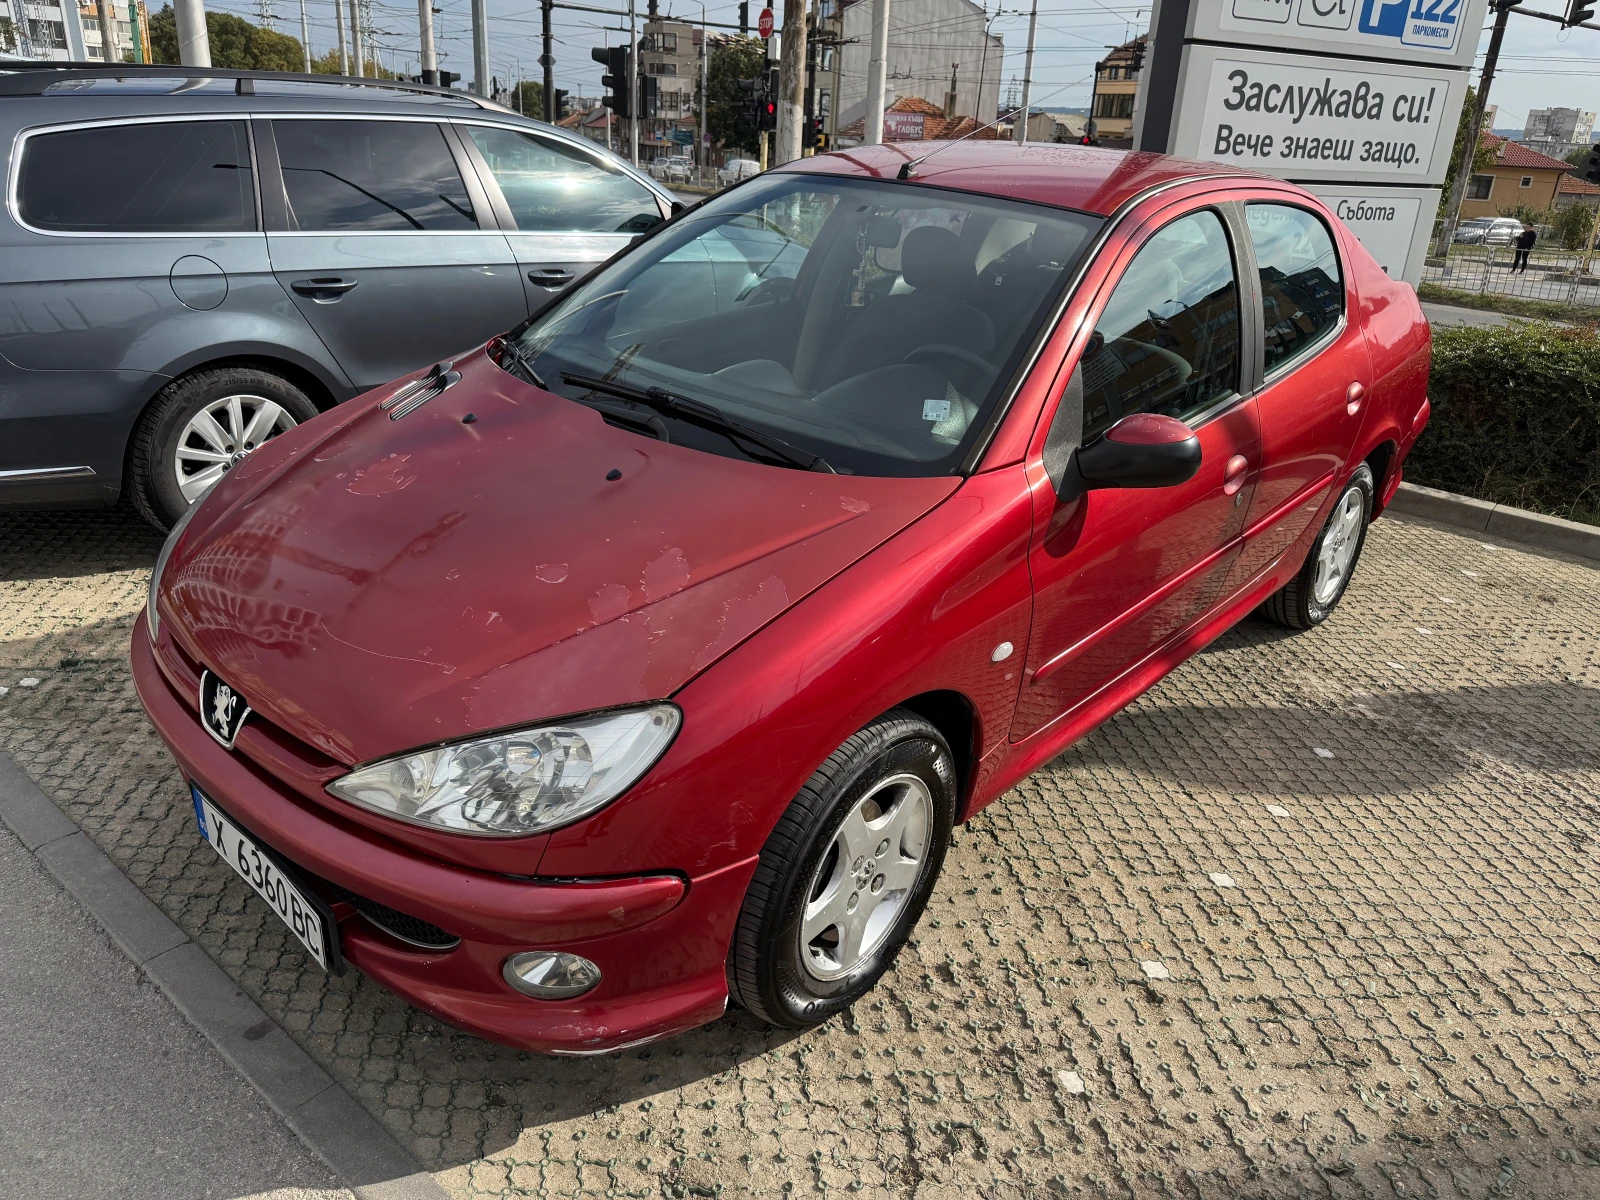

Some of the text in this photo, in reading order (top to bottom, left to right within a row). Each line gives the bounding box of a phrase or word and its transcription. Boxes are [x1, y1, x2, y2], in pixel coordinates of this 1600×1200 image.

[759, 17, 773, 30] STOP
[1412, 24, 1449, 39] ПАРКОМЕСТА
[1223, 69, 1437, 124] Заслужава си!
[897, 125, 923, 134] ГЛОБУС
[1213, 124, 1420, 169] Вече знаеш защо.
[1336, 199, 1396, 221] Събота
[224, 377, 248, 386] 215/55
[237, 838, 287, 917] 6360
